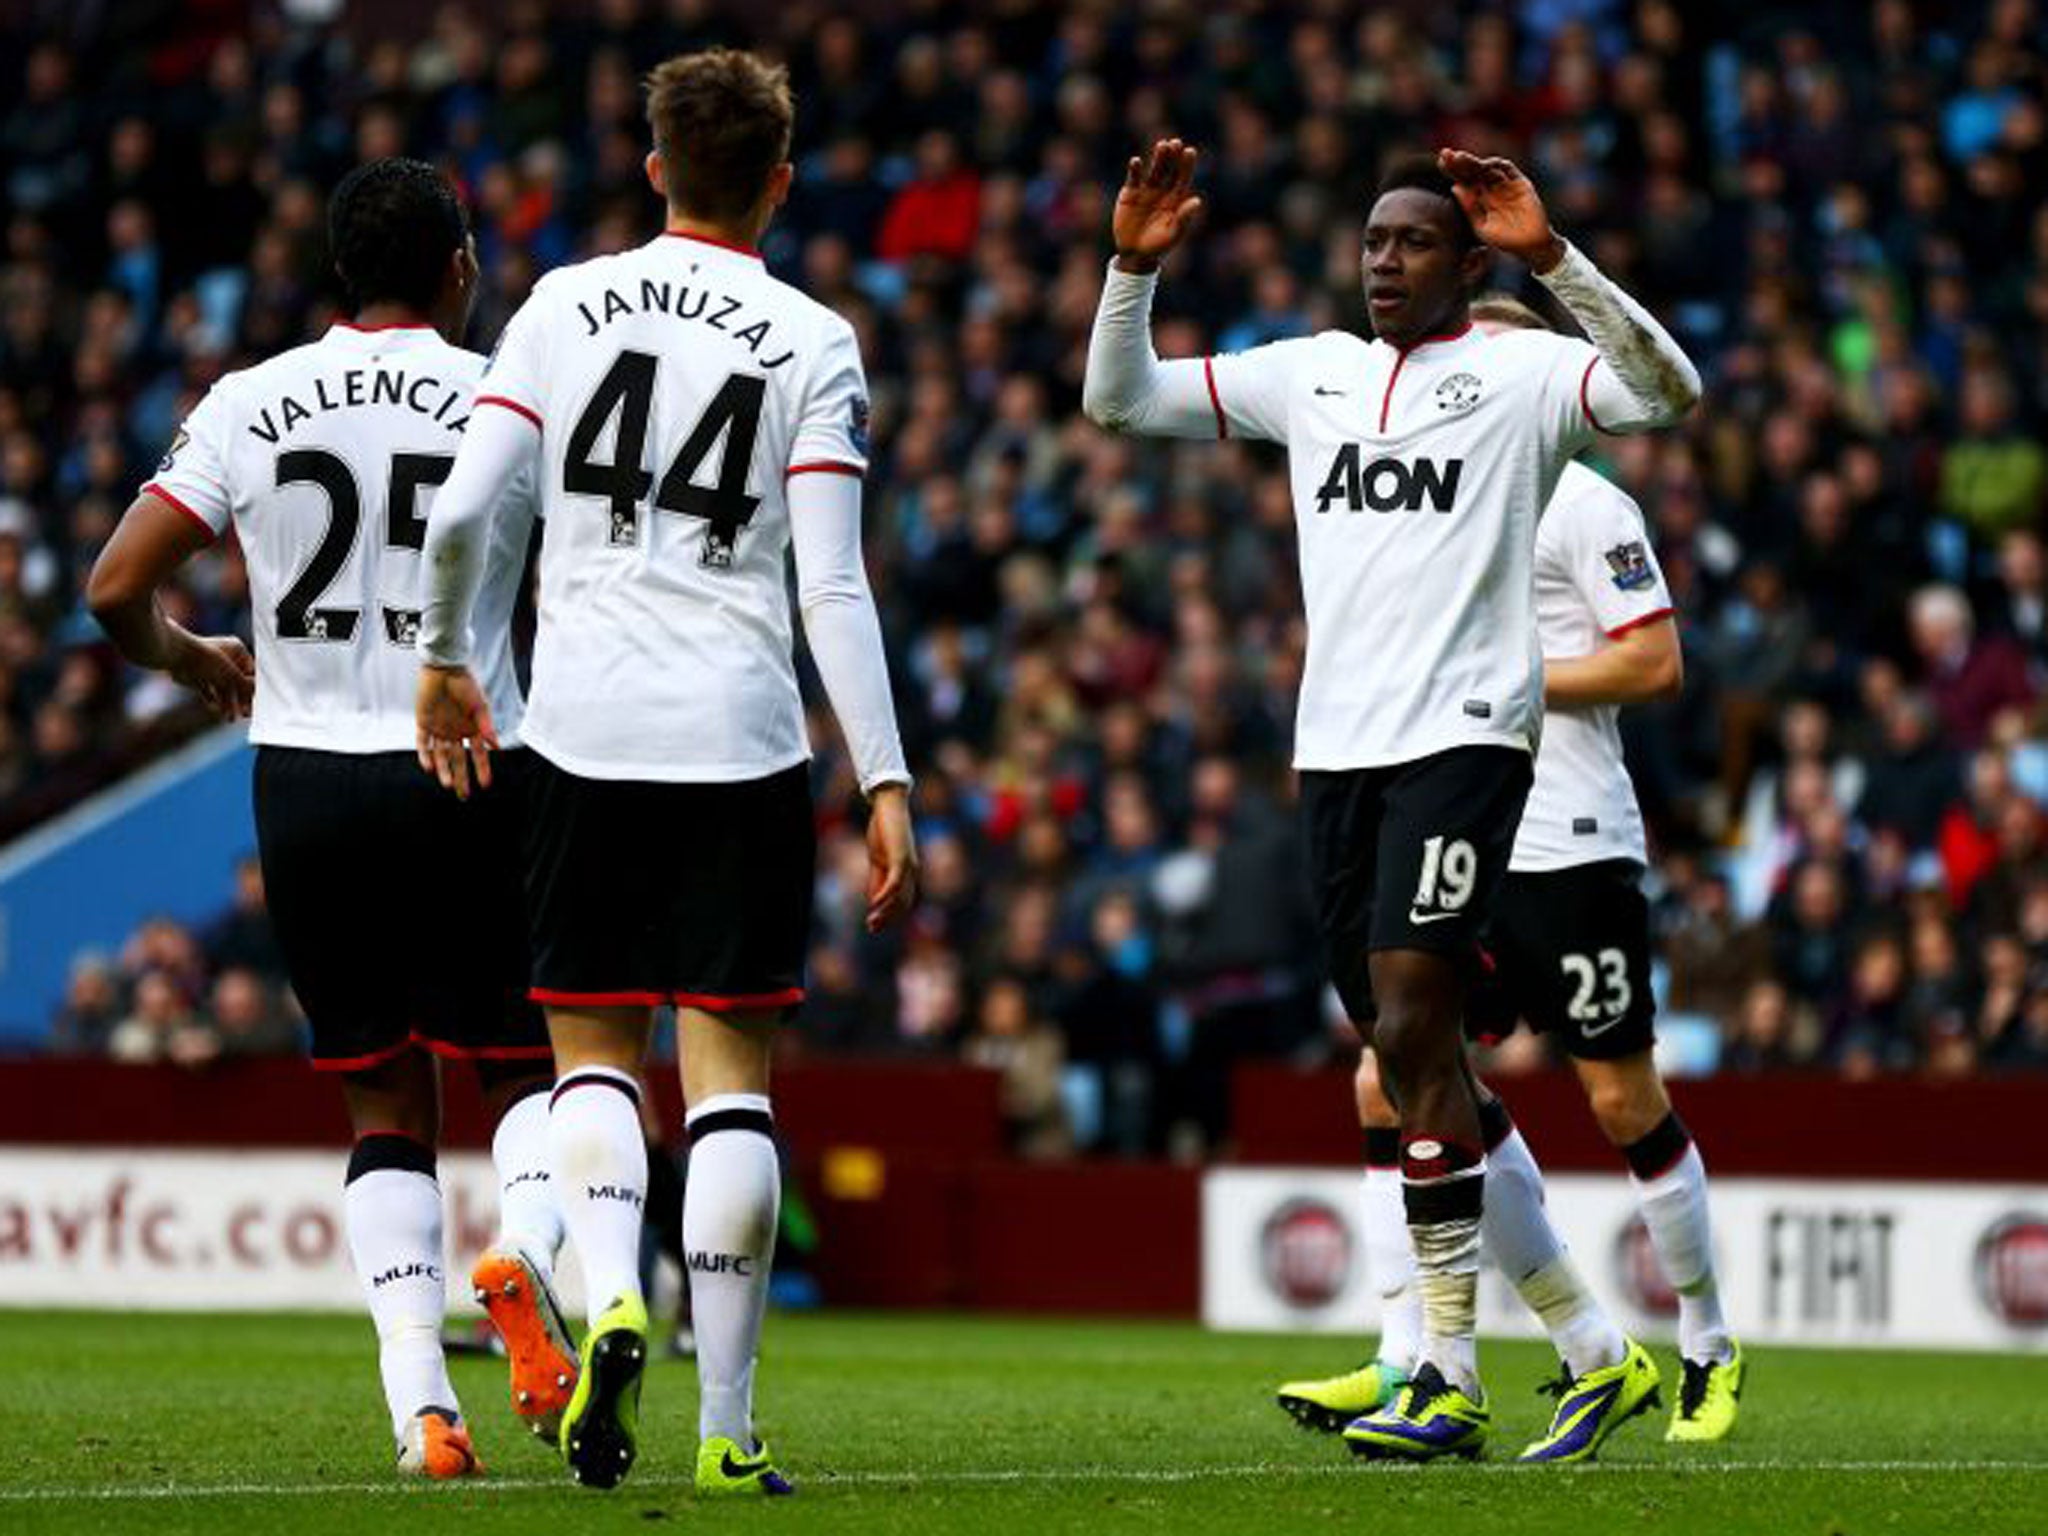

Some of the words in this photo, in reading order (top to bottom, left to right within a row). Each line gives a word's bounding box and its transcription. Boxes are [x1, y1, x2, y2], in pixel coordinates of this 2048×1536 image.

[577, 278, 795, 370] JANUZAJ
[563, 348, 768, 568] 44
[1413, 835, 1478, 910] 19
[1560, 947, 1633, 1021] 23
[373, 1263, 441, 1288] MUFC
[1767, 1209, 1894, 1322] FIAT
